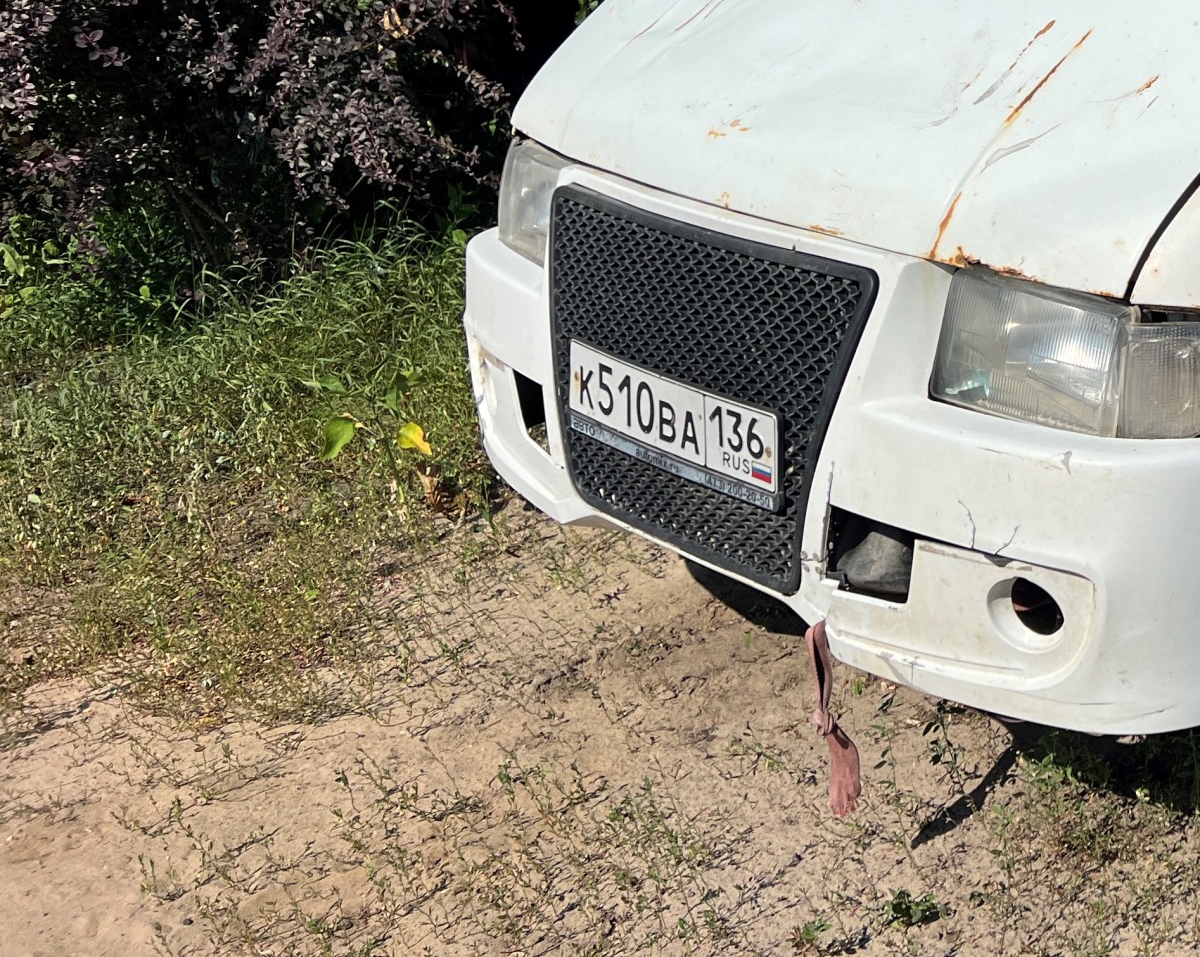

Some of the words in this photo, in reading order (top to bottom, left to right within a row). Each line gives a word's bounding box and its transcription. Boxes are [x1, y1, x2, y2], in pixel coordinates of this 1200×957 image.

[579, 362, 700, 455] К510ВА
[709, 405, 764, 459] 136
[722, 452, 750, 475] RUS
